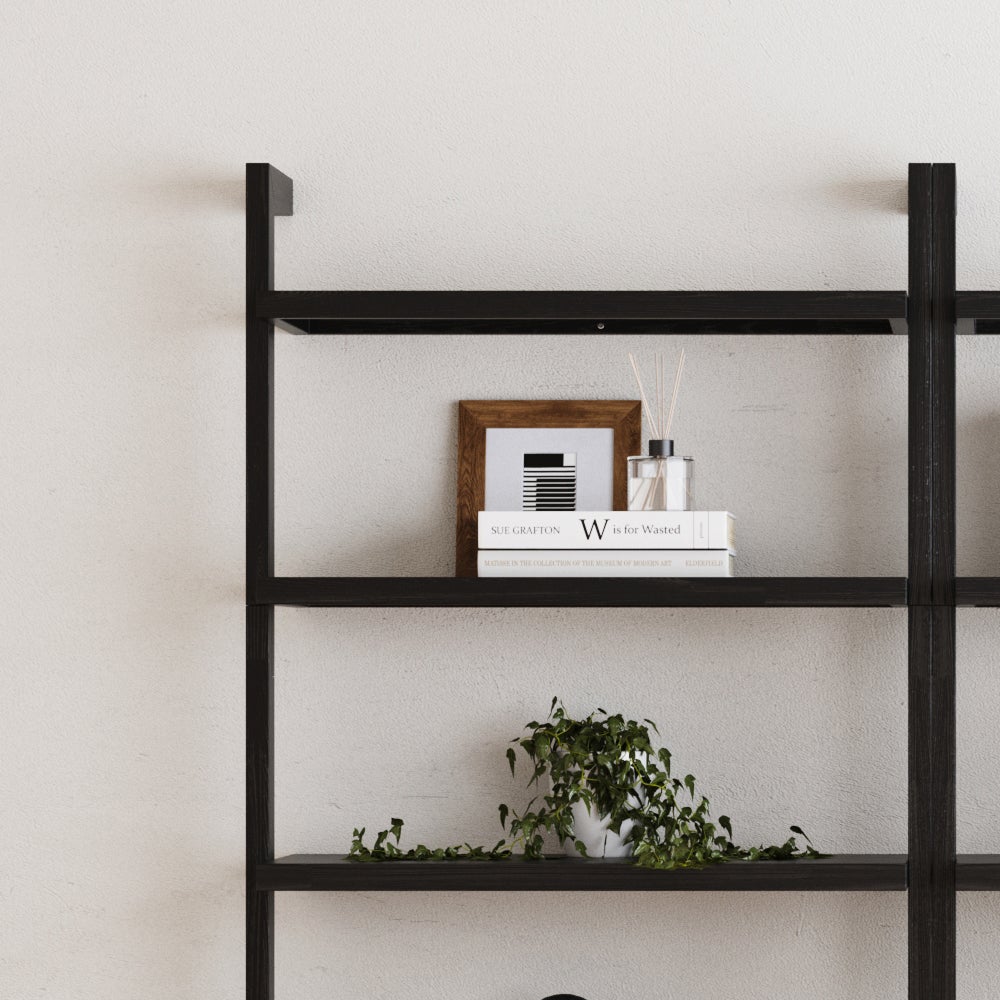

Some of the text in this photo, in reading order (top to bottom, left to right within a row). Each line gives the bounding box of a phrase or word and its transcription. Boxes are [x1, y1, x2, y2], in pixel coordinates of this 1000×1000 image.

[491, 526, 560, 535] SUE GRAFTON
[579, 519, 681, 540] W is for Wasted
